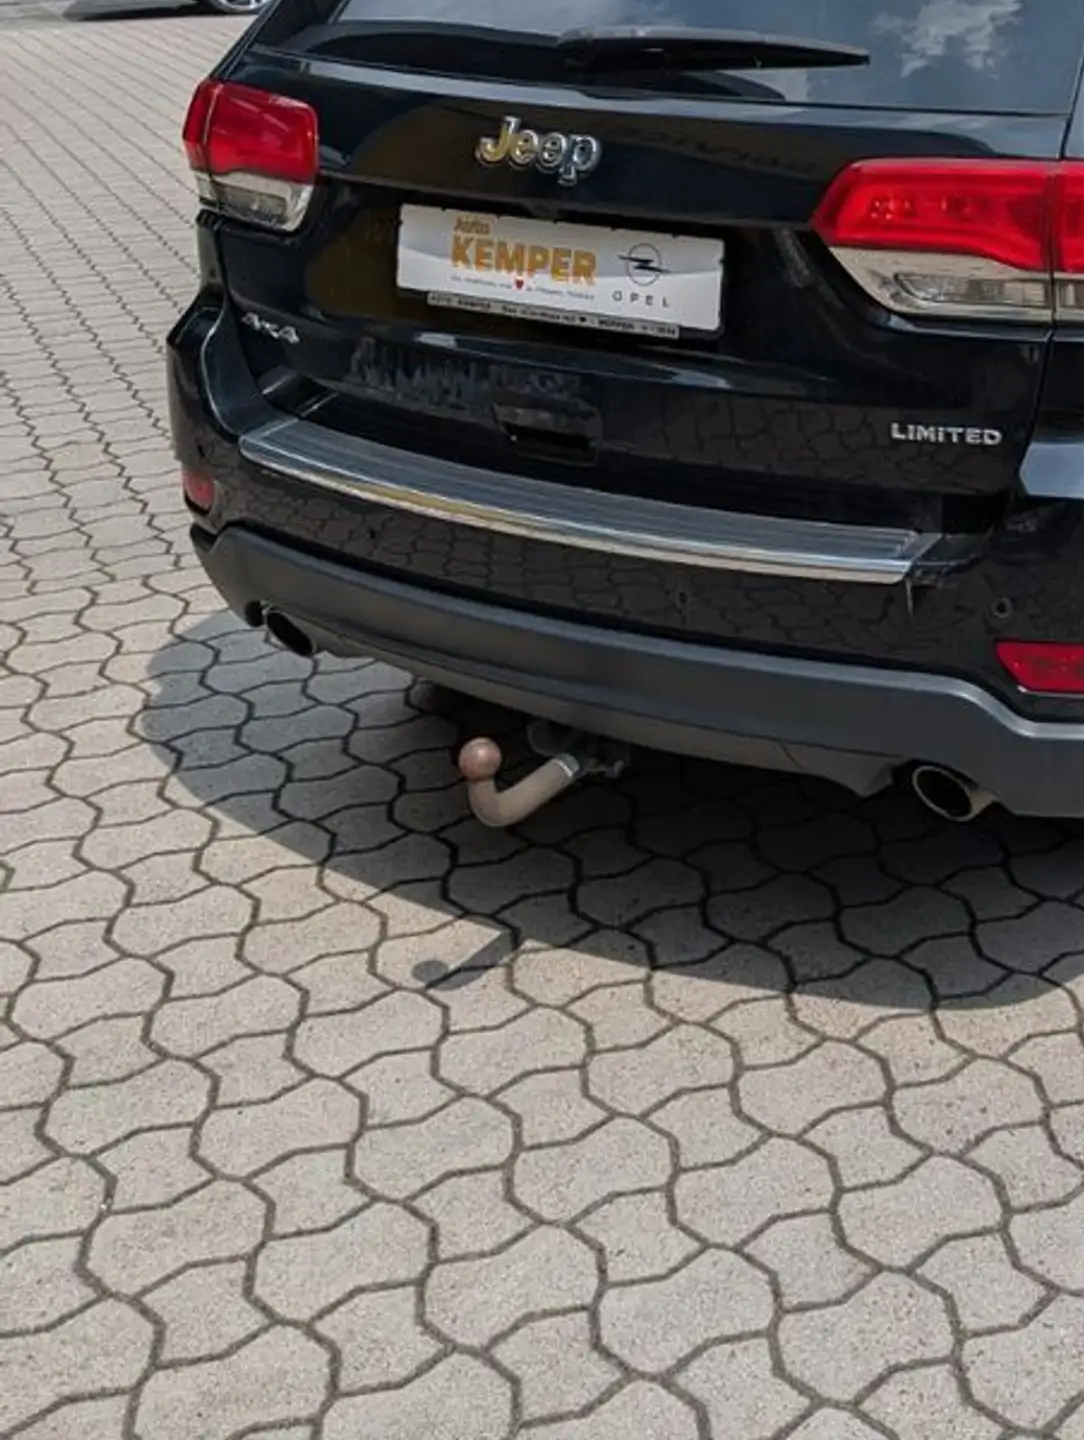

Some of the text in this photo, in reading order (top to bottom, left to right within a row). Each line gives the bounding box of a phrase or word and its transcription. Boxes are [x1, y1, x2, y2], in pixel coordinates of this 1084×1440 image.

[475, 114, 602, 187] Jeep
[451, 234, 597, 286] KEMPER
[612, 290, 671, 308] OPEL
[889, 422, 1003, 446] LIMITED
